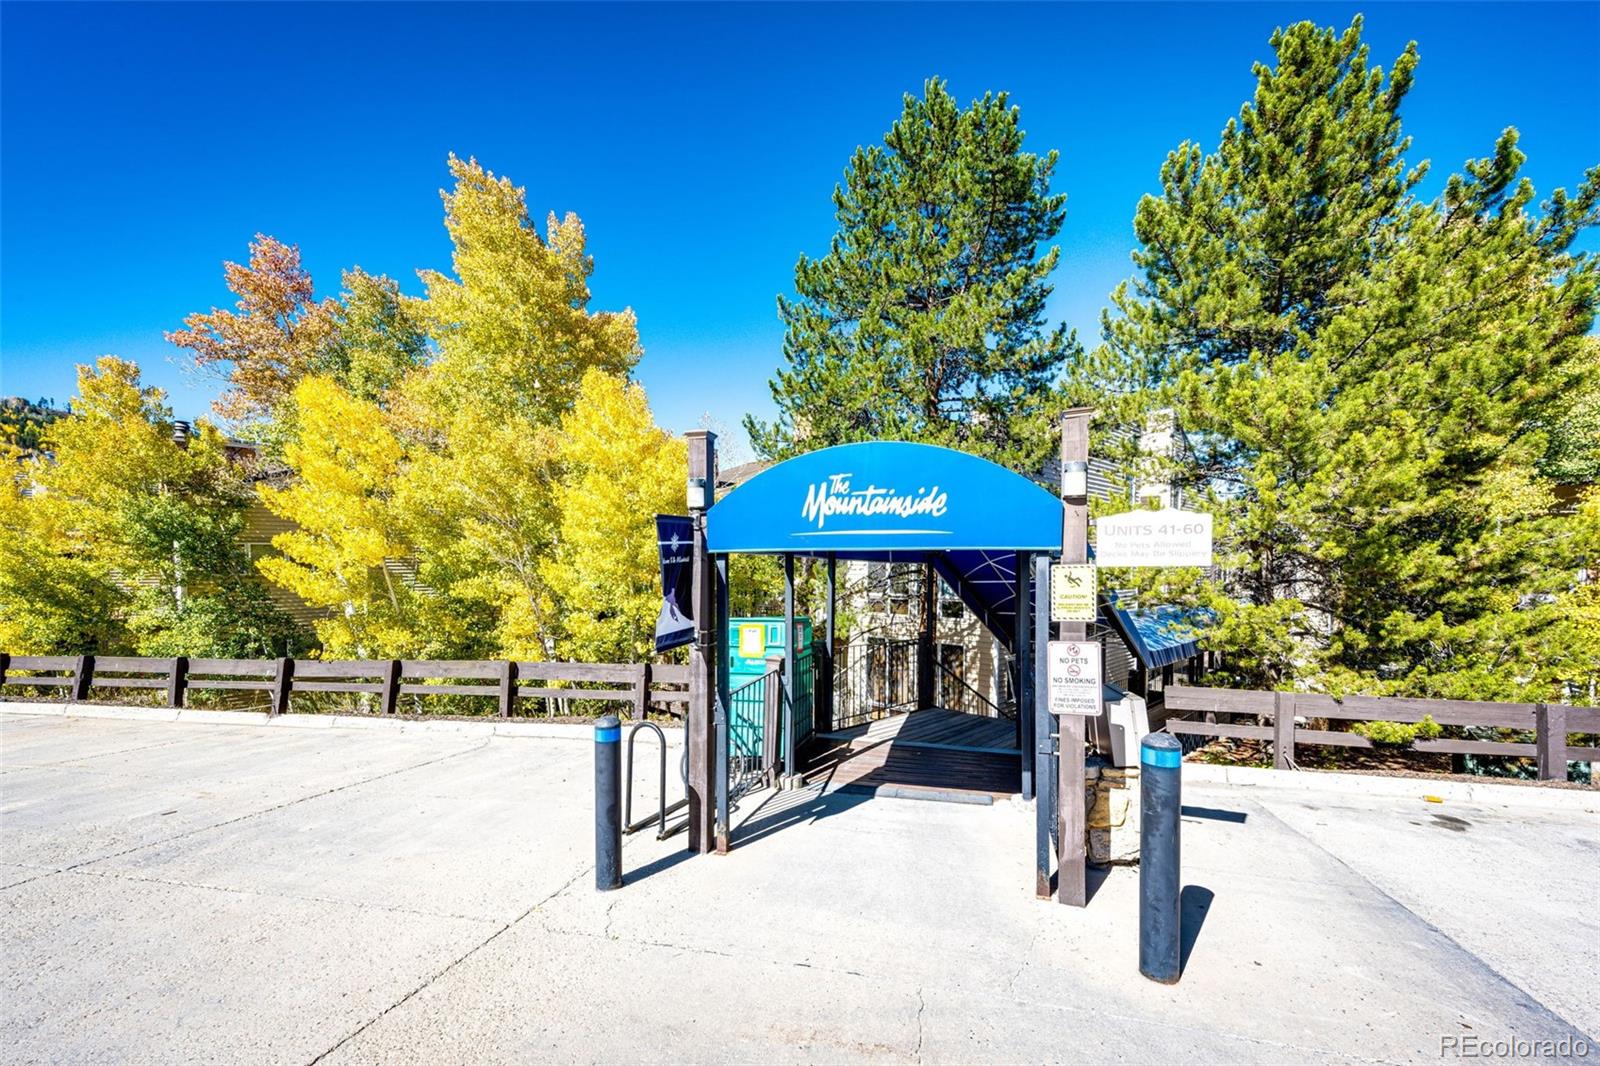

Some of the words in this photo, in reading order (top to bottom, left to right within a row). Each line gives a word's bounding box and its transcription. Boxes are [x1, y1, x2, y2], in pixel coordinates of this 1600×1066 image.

[829, 473, 853, 495] The
[801, 481, 948, 529] Mountainside
[1104, 524, 1153, 536] UNITS
[1158, 523, 1204, 535] 41-60
[1153, 541, 1191, 549] Allowed
[1064, 677, 1096, 685] SMOKING
